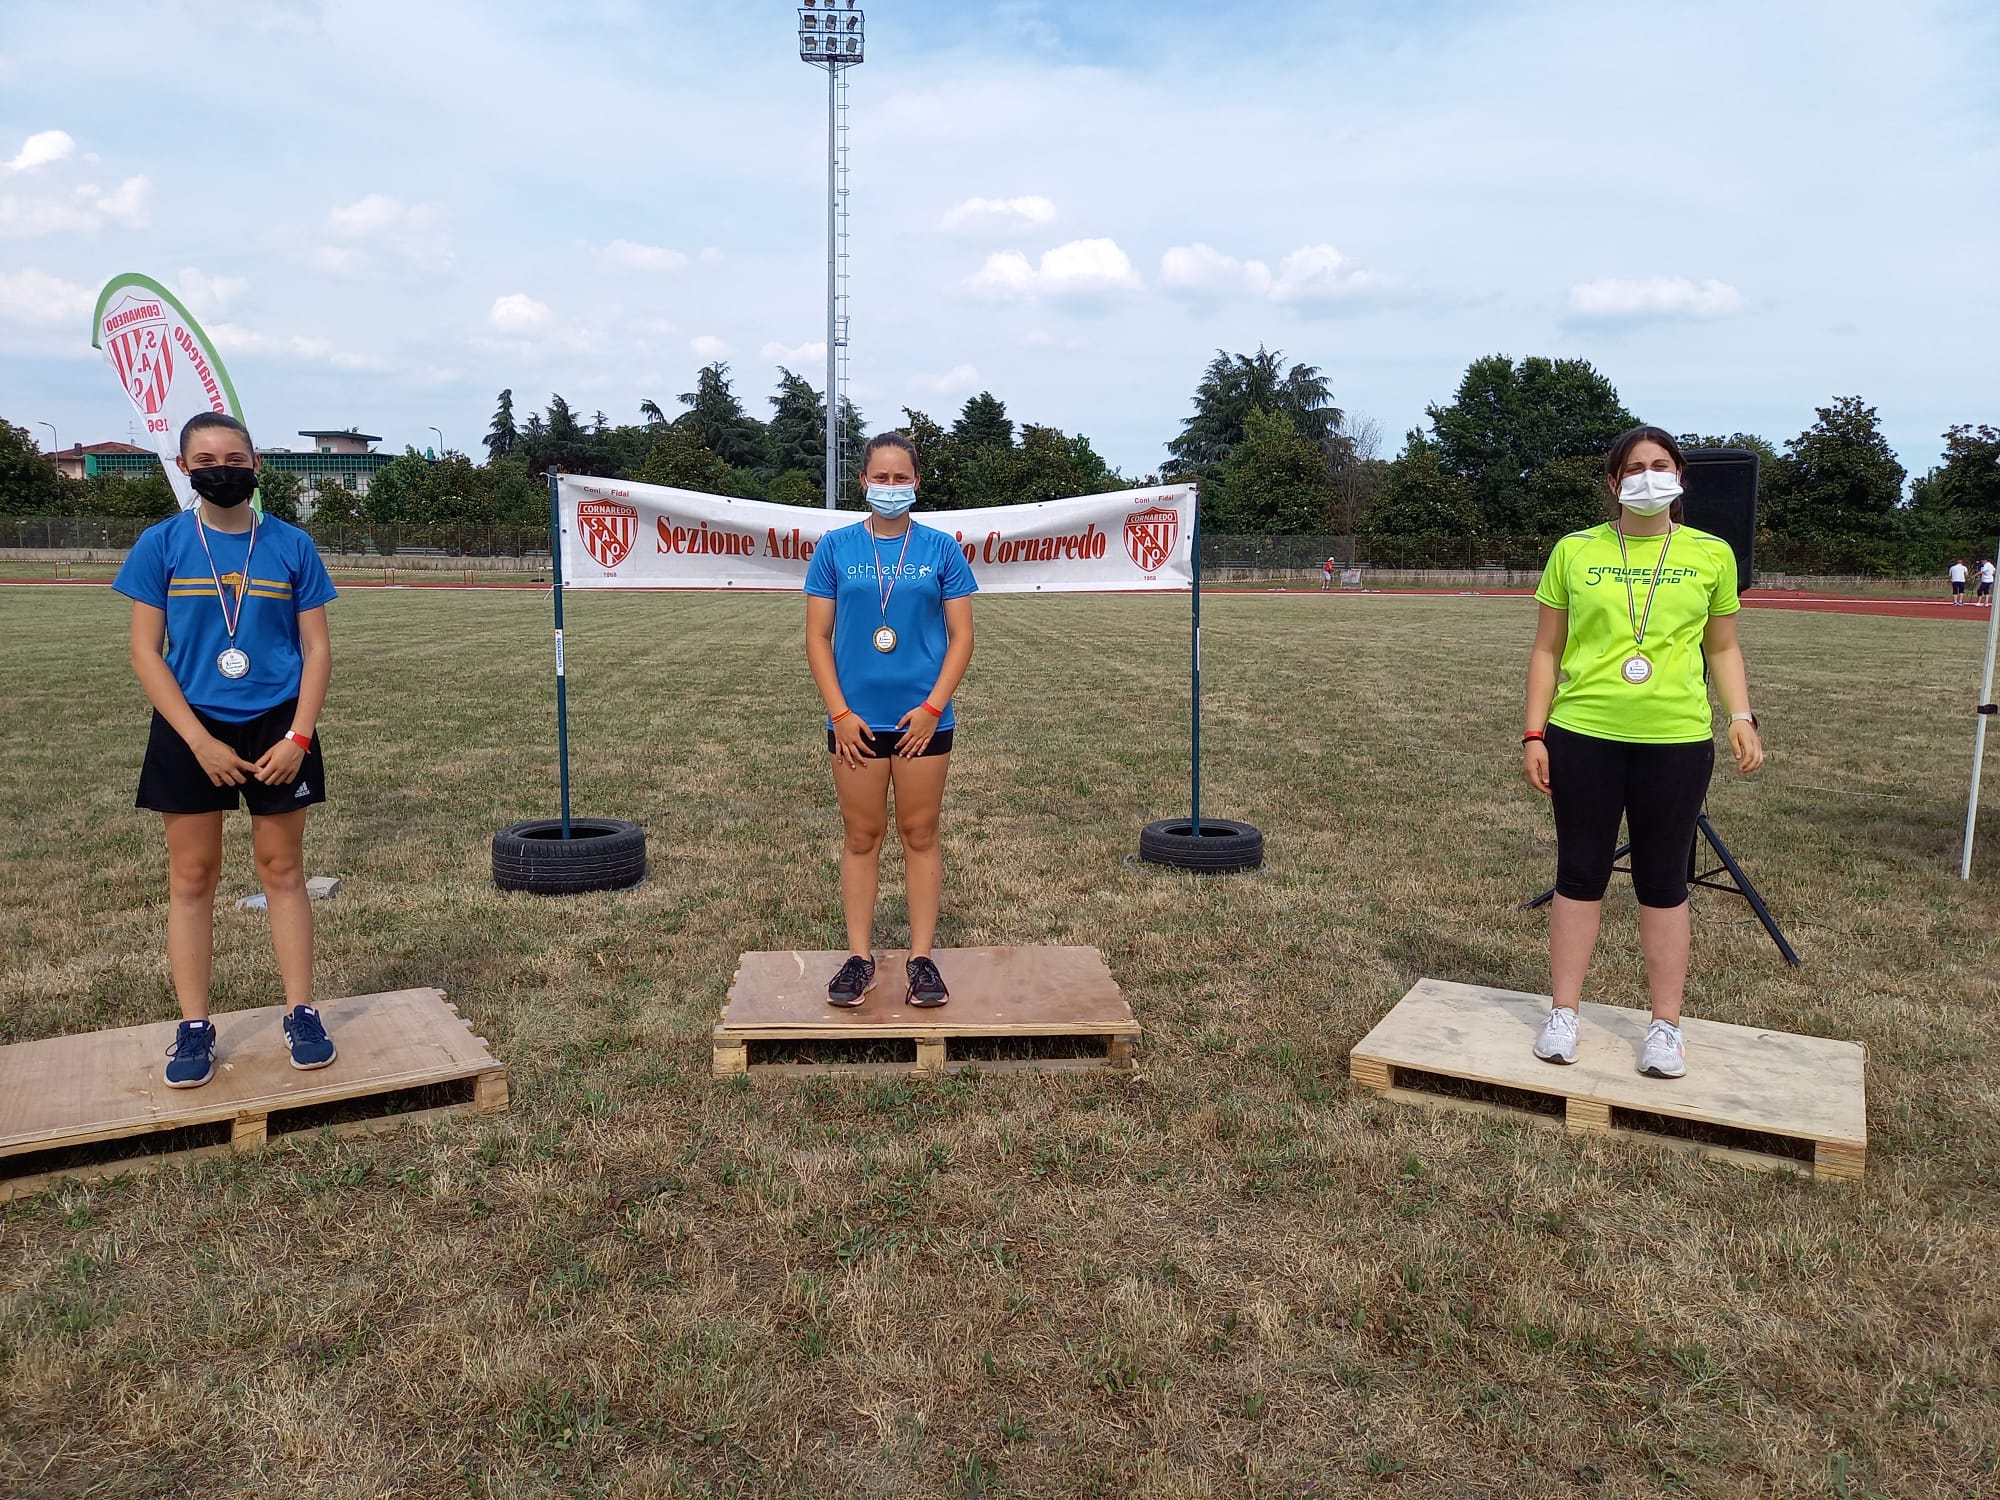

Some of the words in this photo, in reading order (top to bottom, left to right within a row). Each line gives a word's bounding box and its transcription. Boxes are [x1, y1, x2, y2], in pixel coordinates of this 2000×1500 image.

[583, 486, 601, 494] Coni
[611, 489, 630, 497] Fidal
[1158, 494, 1174, 502] Fidal
[582, 504, 633, 515] CORNAREDO
[1130, 513, 1173, 523] CORNAREDO
[656, 514, 755, 556] Sezione
[763, 526, 830, 562] Atle
[982, 522, 1107, 565] Cornaredo
